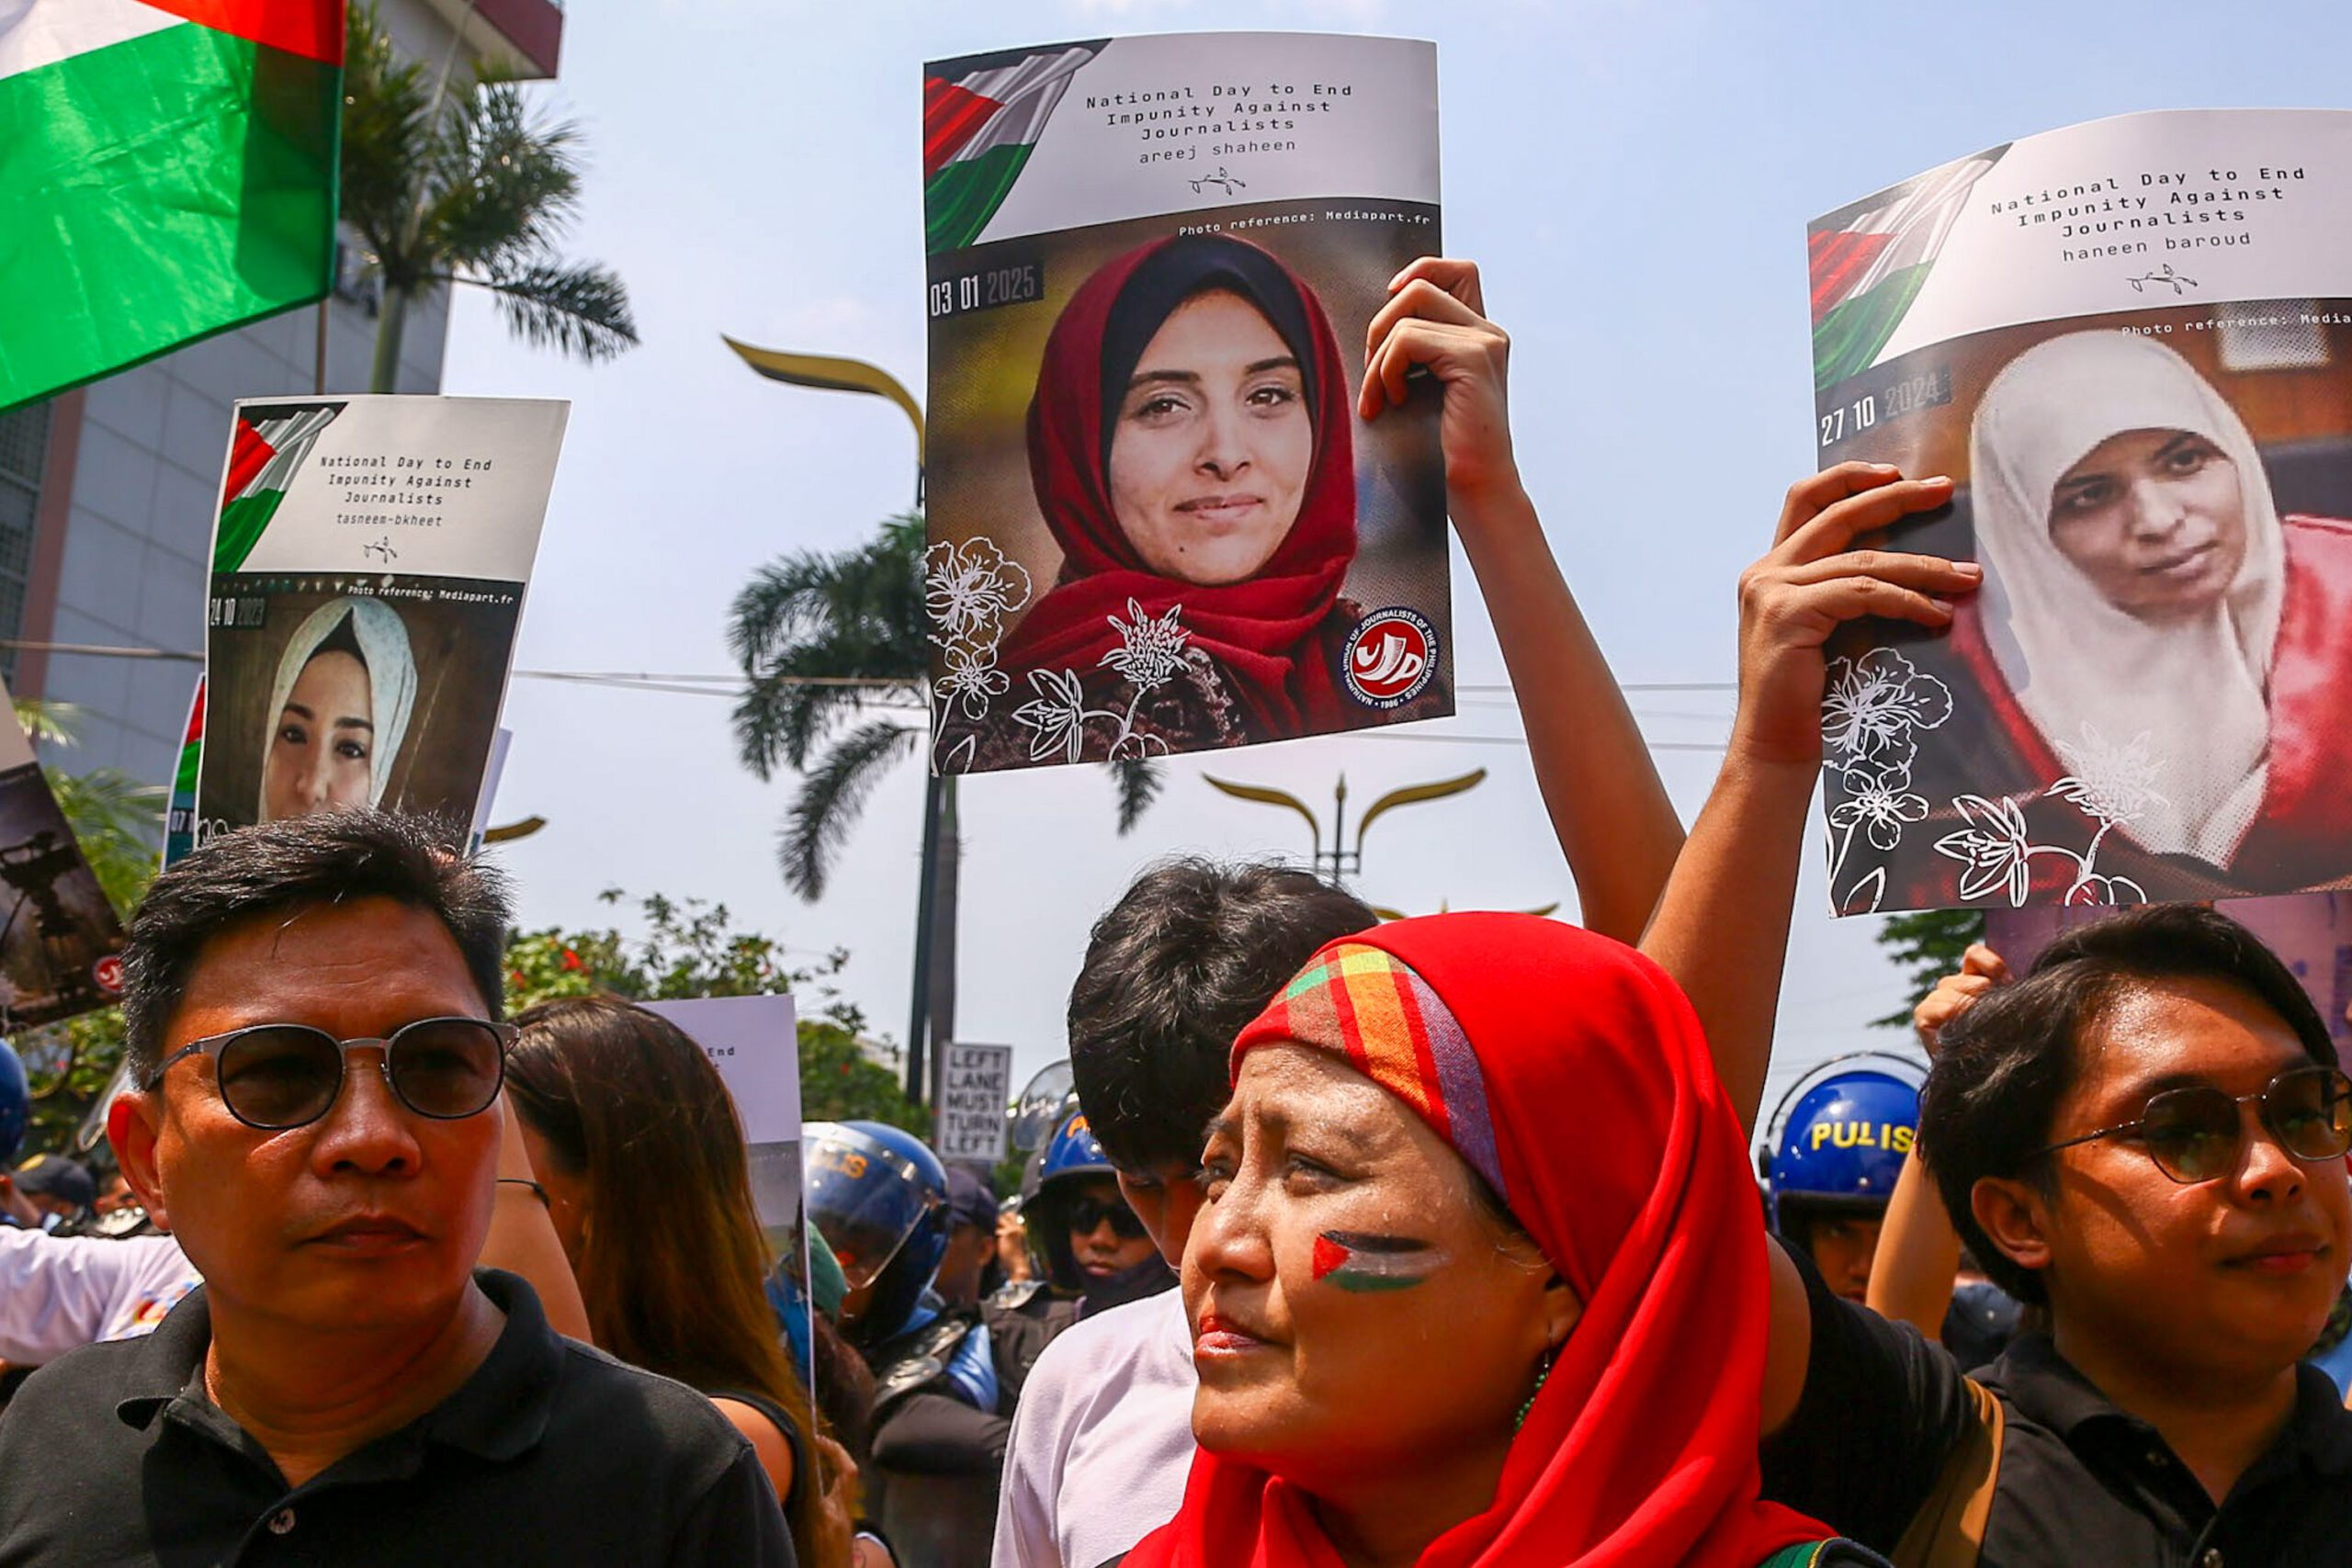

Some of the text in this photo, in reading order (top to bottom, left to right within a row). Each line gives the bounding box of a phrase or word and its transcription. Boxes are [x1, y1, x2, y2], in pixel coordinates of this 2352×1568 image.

[1086, 83, 1352, 109] National Day to End
[1107, 100, 1330, 126] Impunity Against
[1141, 118, 1295, 141] Journalists
[1139, 141, 1296, 164] areej shaheen
[1991, 167, 2305, 215] National Day to End
[2018, 186, 2284, 228] Impunity Against
[1179, 209, 1430, 236] Photo reference: Mediapart.fr
[2062, 209, 2245, 238] Journalists
[2063, 231, 2251, 263] haneen baroud
[930, 265, 1035, 317] 03 01 2025
[2121, 323, 2173, 336] Photo
[2185, 316, 2288, 332] reference:
[1821, 371, 1941, 447] 27 10 2024
[320, 456, 492, 471] National Day to End
[328, 473, 472, 489] Impunity Against
[345, 491, 443, 505] Journalists
[336, 513, 443, 527] tasneem-bkheet
[347, 585, 514, 604] Photo reference: Mediapart.fr
[210, 597, 221, 626] 24
[223, 597, 236, 626] 10
[1342, 610, 1437, 706] NATIONAL UNION OF JOURNALISTS OF THE PHILIPPINES
[707, 1046, 735, 1056] End
[950, 1050, 1001, 1068] LEFT
[947, 1072, 1002, 1090] LANE
[947, 1092, 1000, 1111] MUST
[947, 1112, 1000, 1133] TURN
[944, 1134, 995, 1154] LEFT
[1811, 1122, 1914, 1153] PULIS
